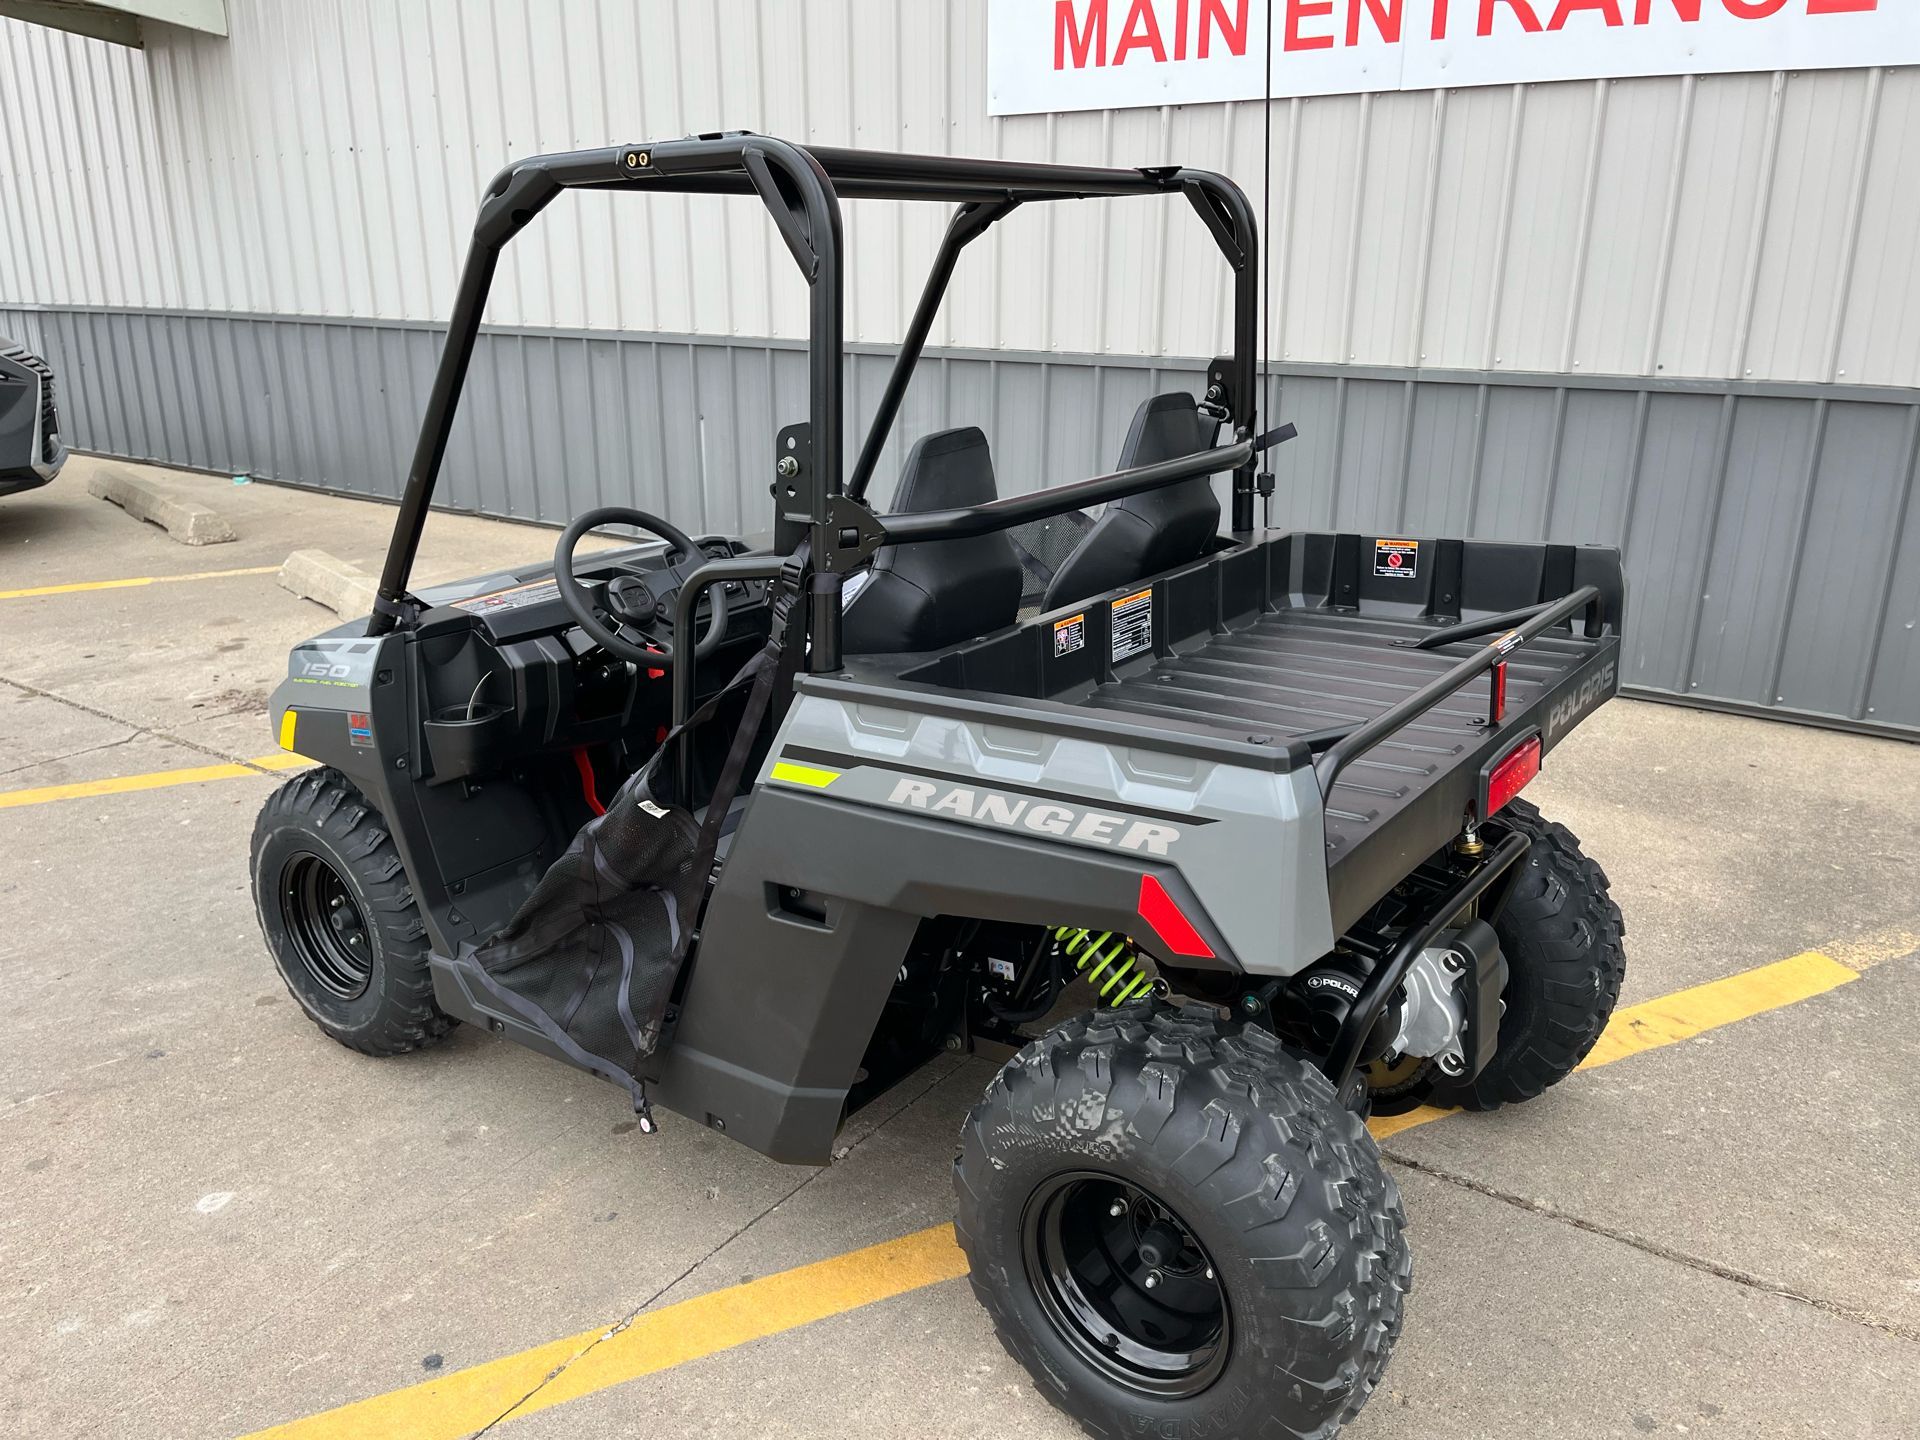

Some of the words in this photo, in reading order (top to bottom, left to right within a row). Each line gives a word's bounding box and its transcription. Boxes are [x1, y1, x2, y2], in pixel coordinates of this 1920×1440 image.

[1053, 0, 1249, 70] MAIN
[302, 663, 351, 677] 150
[1548, 661, 1616, 736] POLARIS
[888, 779, 1180, 856] RANGER
[1323, 979, 1358, 997] POLAR
